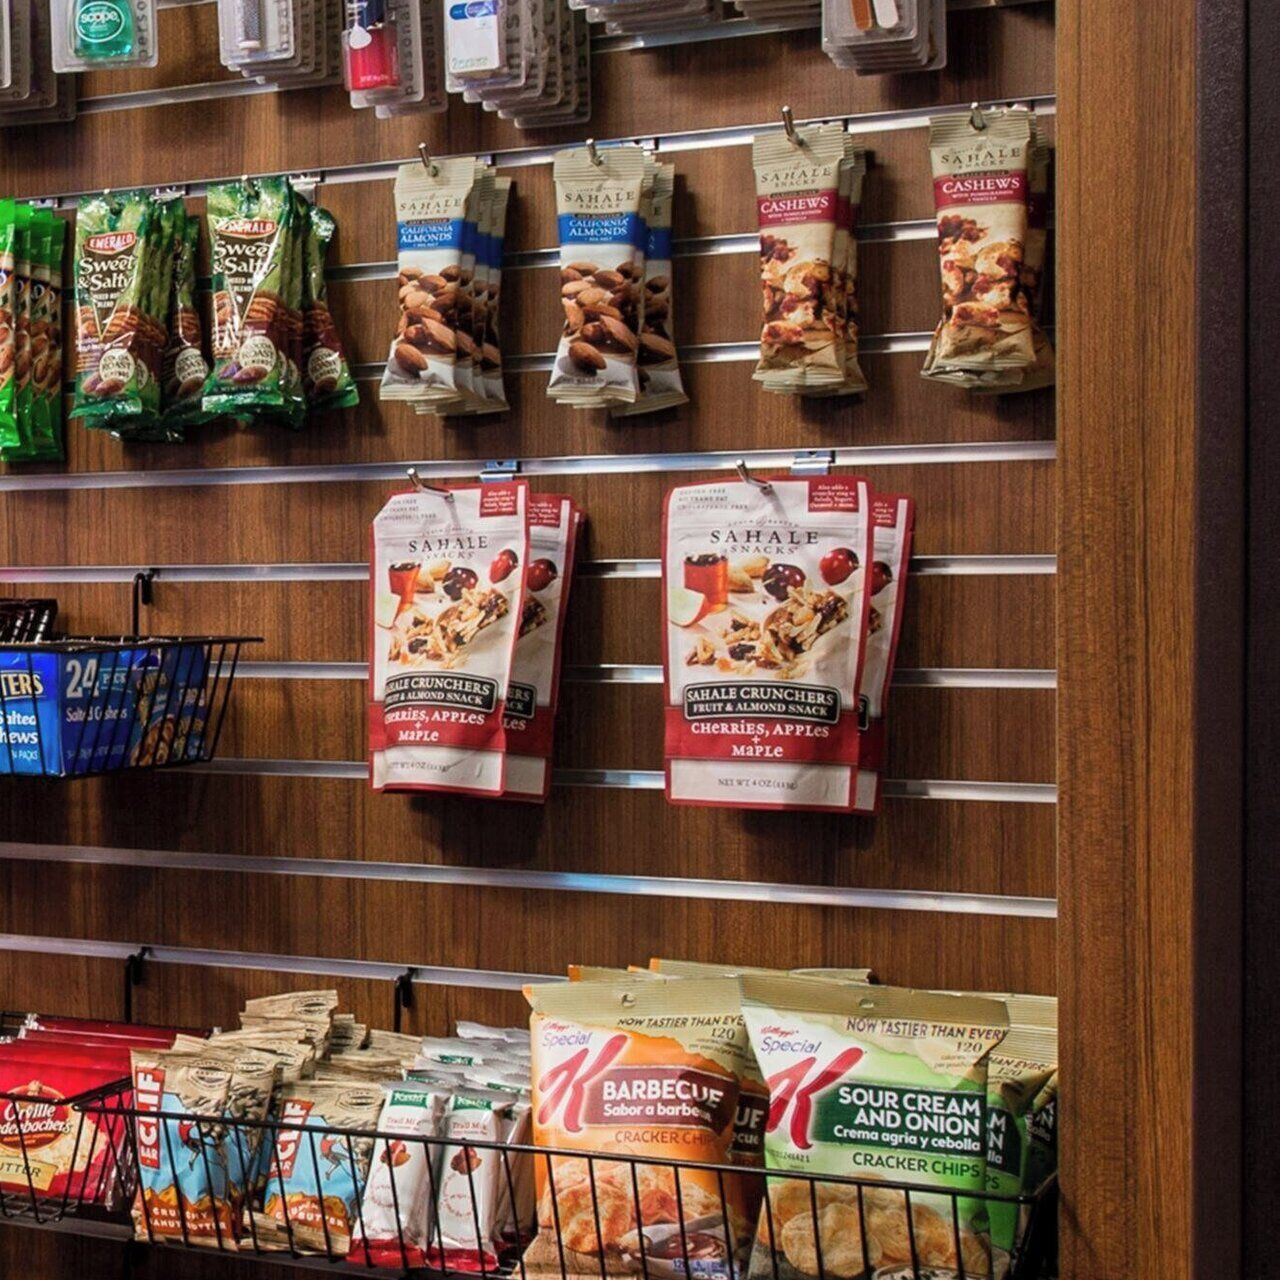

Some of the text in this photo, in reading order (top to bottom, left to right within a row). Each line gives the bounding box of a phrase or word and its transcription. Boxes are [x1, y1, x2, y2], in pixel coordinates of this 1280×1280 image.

[80, 10, 118, 25] scope
[941, 147, 1020, 164] SAHALE
[760, 167, 833, 184] SAHALE
[942, 178, 1020, 195] CASHEWS
[399, 198, 462, 212] SAHALE
[564, 192, 635, 205] SAHALE
[760, 196, 829, 213] CASHEWS
[569, 217, 628, 228] CALIFORNIA
[400, 232, 452, 243] ALMONDS
[569, 226, 628, 237] ALMONDS
[79, 255, 137, 275] Sweet
[409, 536, 488, 554] SAHALE
[710, 529, 819, 545] SAHALE
[729, 544, 795, 555] SNACKS
[66, 658, 100, 699] 24
[410, 677, 491, 696] CRUNCHERS
[407, 690, 445, 701] ALMOND
[446, 694, 483, 706] SNACK
[687, 686, 835, 707] SAHALE CRUNCHERS
[693, 702, 828, 717] FRUIT & ALMOND SNACK
[618, 1016, 721, 1028] NOW TASTIER THAN
[846, 1019, 966, 1039] NOW TASTIER THAN
[542, 1031, 592, 1047] Special
[711, 1026, 735, 1040] 120
[761, 1036, 822, 1054] Special
[955, 1040, 983, 1053] 120
[538, 1034, 628, 1133] K
[602, 1078, 724, 1110] BARBECUE
[765, 1047, 865, 1151] K
[839, 1086, 980, 1117] SOUR CREAM
[603, 1102, 656, 1117] Sabor a
[853, 1109, 980, 1137] AND ONION
[615, 1130, 679, 1145] CRACKER
[833, 1124, 980, 1152] Crema agria y cebolla
[853, 1151, 980, 1178] CRACKER CHIPS
